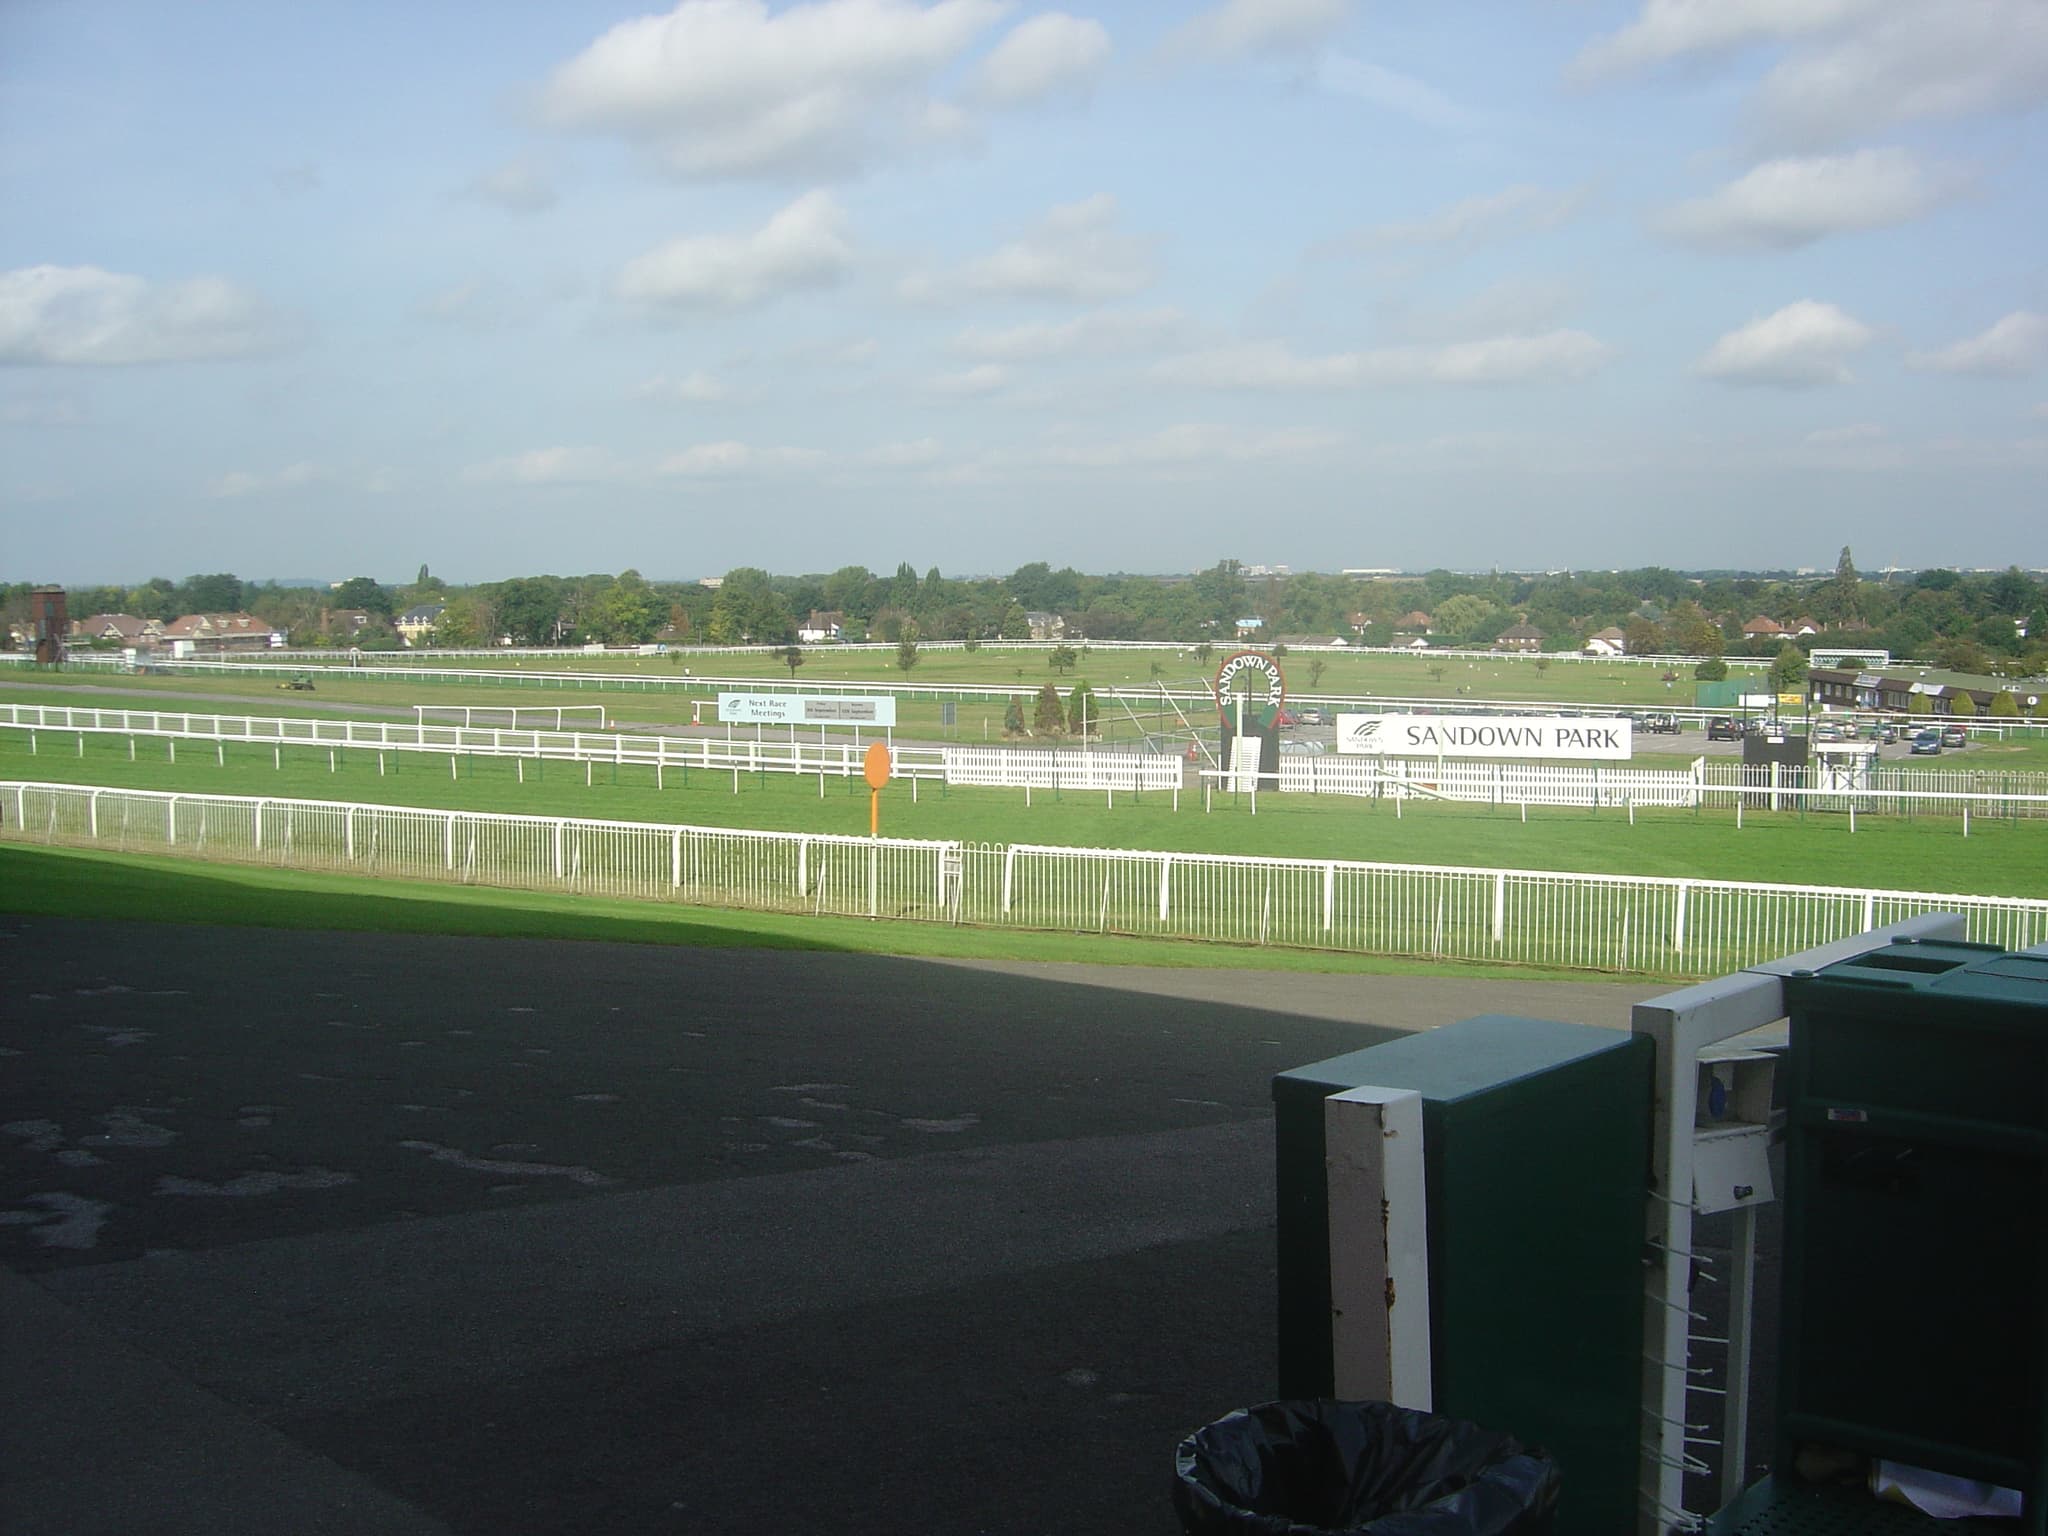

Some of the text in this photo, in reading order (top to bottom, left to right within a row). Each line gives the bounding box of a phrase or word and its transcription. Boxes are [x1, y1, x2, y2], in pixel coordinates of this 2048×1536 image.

[1219, 655, 1283, 708] SANDOWN PARK
[748, 699, 787, 708] Next Race
[751, 709, 786, 719] Meetings
[1407, 724, 1620, 749] SANDOWN PARK
